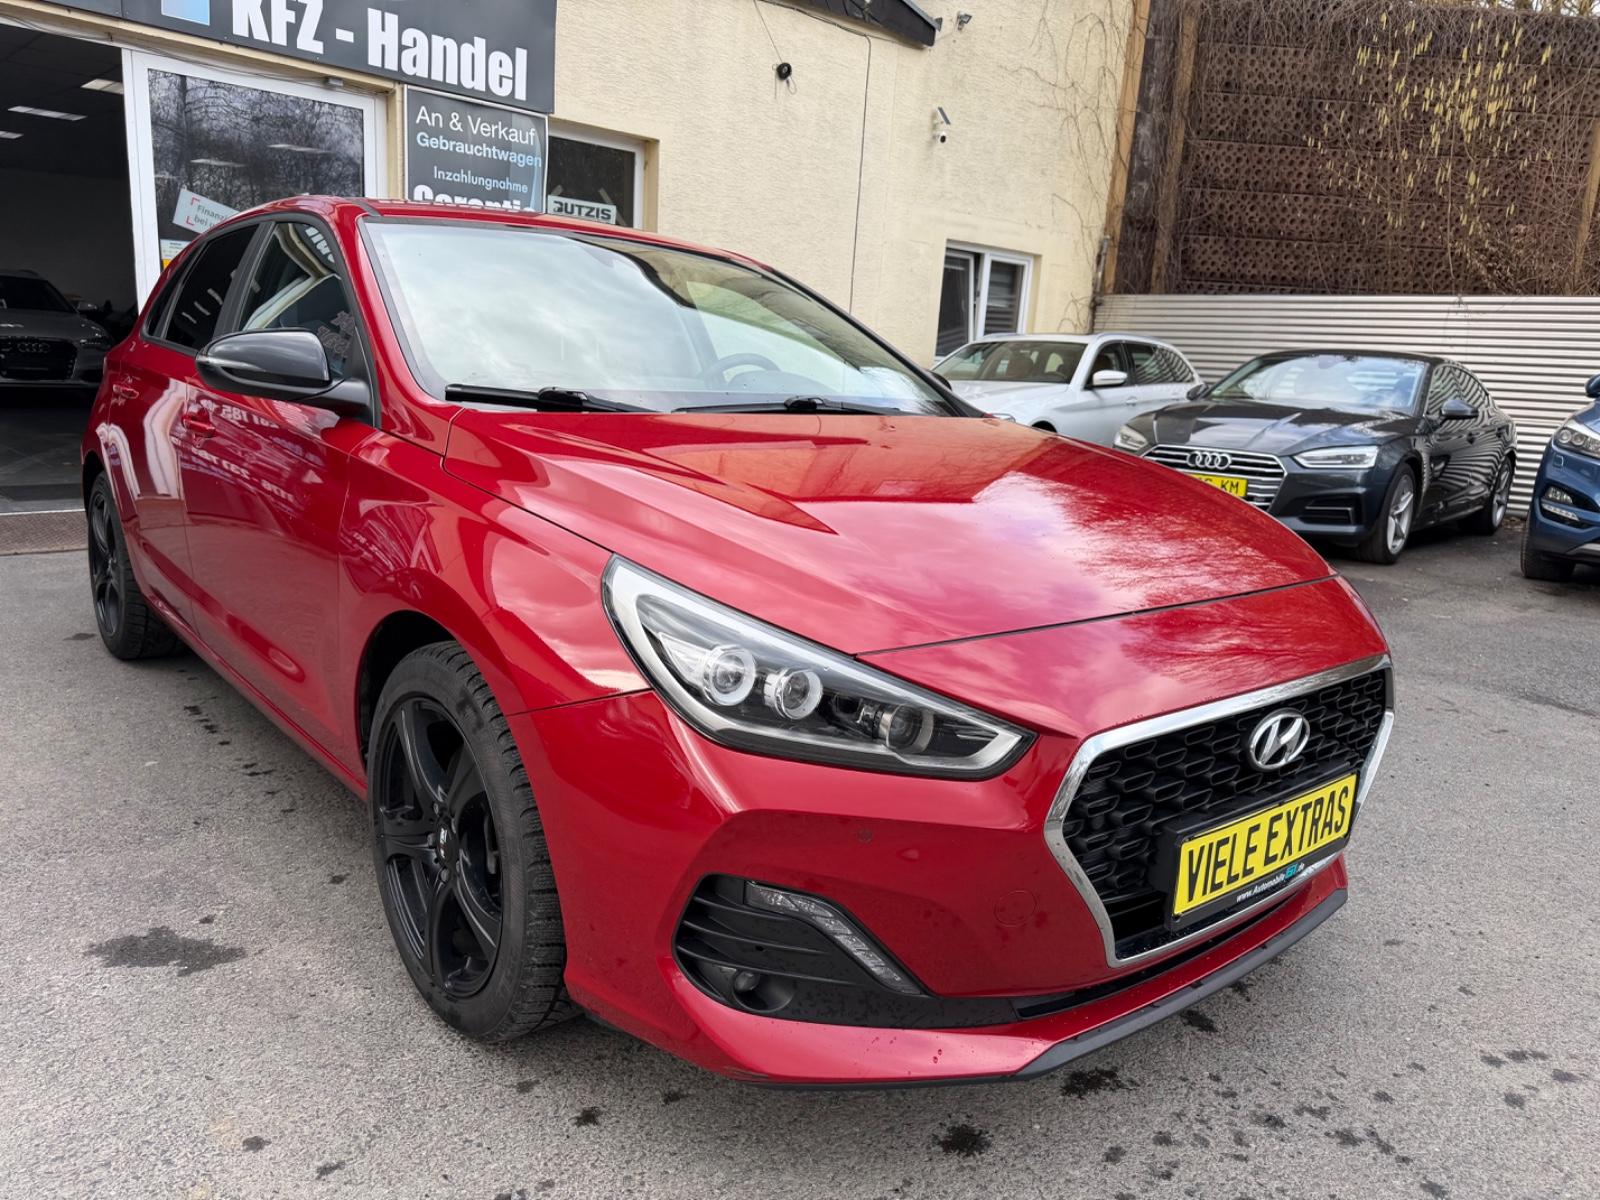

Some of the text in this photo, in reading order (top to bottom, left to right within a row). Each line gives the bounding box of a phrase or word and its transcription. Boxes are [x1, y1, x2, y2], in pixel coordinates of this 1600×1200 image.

[232, 0, 323, 54] KFZ
[368, 8, 527, 101] Handel
[416, 106, 536, 146] An & Verkauf
[416, 132, 542, 167] Gebrauchtwagen
[434, 166, 528, 193] Inzahlungnahme
[1188, 785, 1349, 903] VIELE EXTRAS
